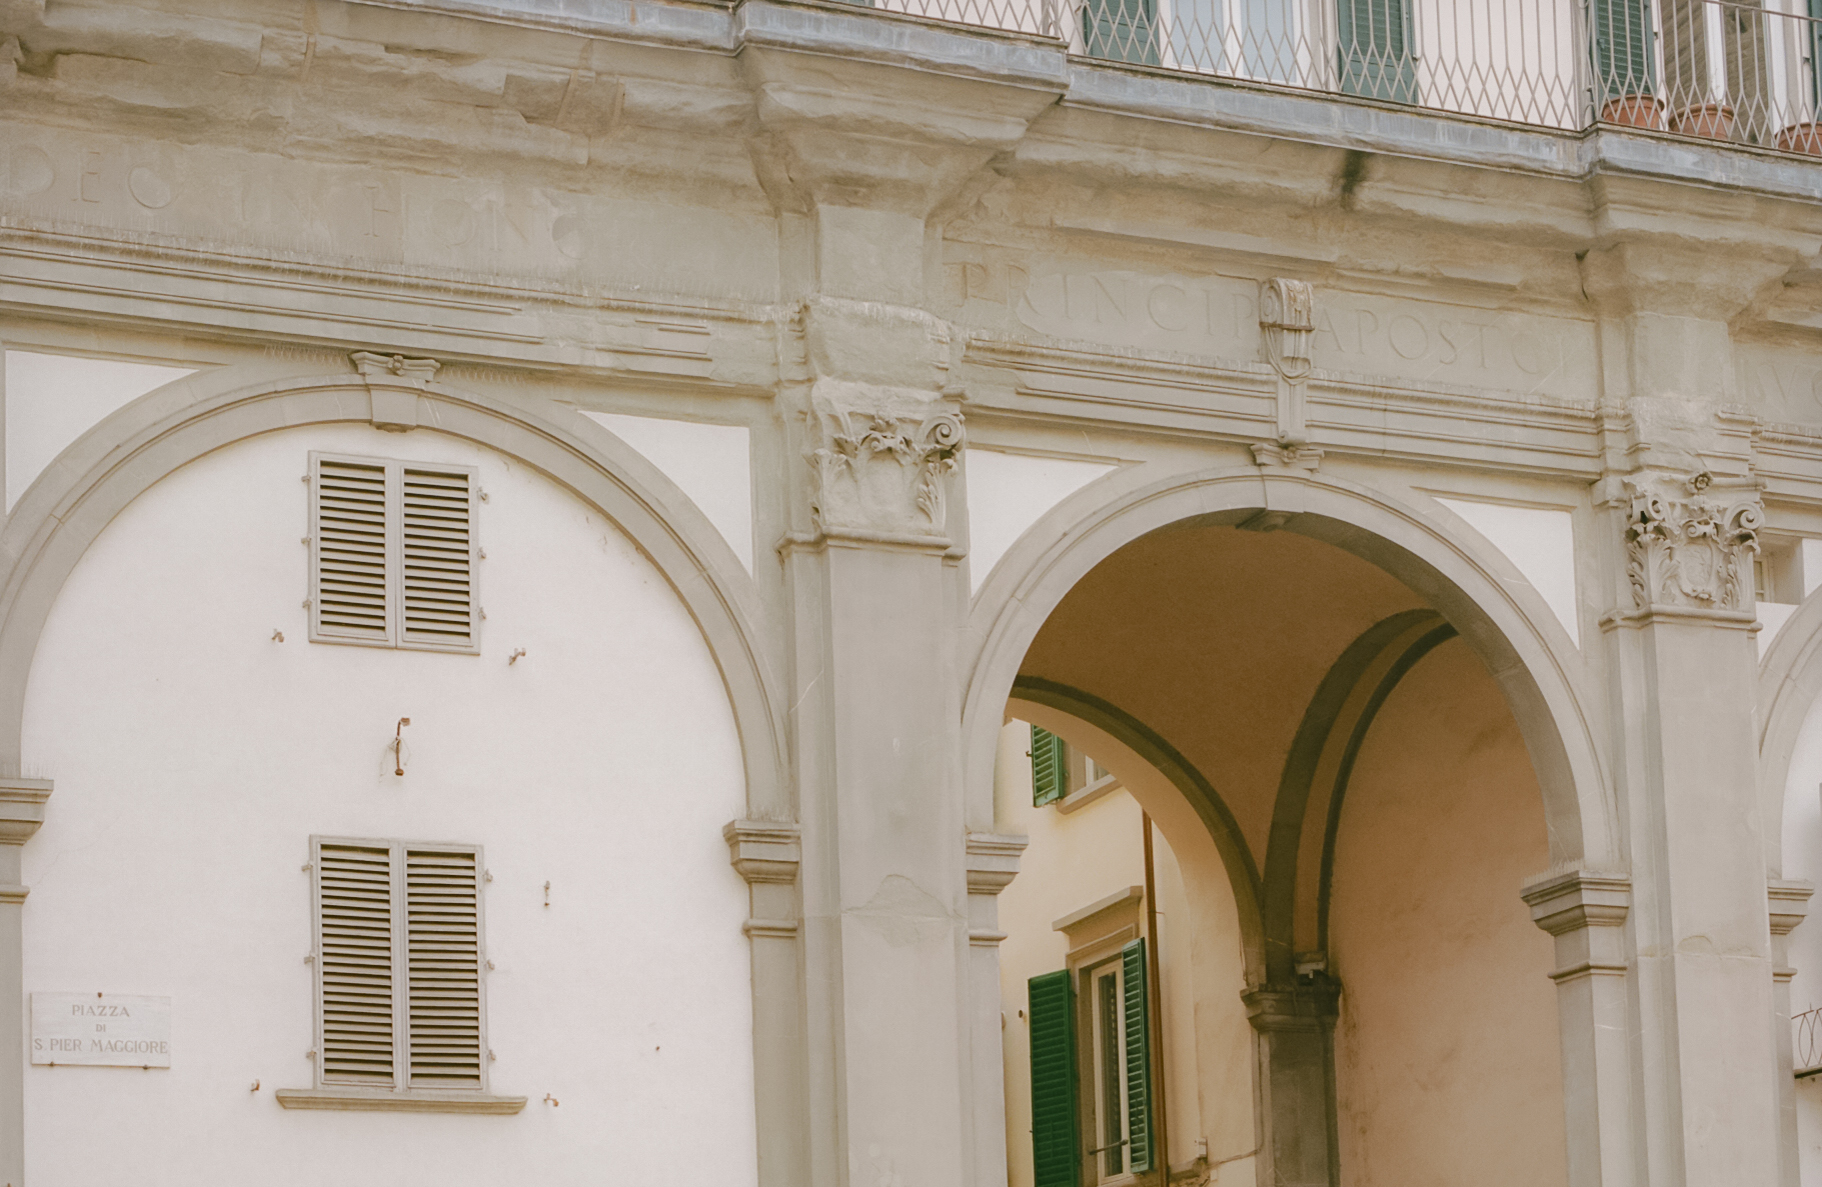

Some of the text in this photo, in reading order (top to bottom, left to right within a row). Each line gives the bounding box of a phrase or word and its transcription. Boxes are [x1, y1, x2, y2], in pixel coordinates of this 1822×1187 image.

[72, 1004, 130, 1017] PIAZZA
[95, 1023, 106, 1033] DI
[50, 1039, 82, 1051] PIER
[90, 1039, 168, 1054] MAGGIORE
